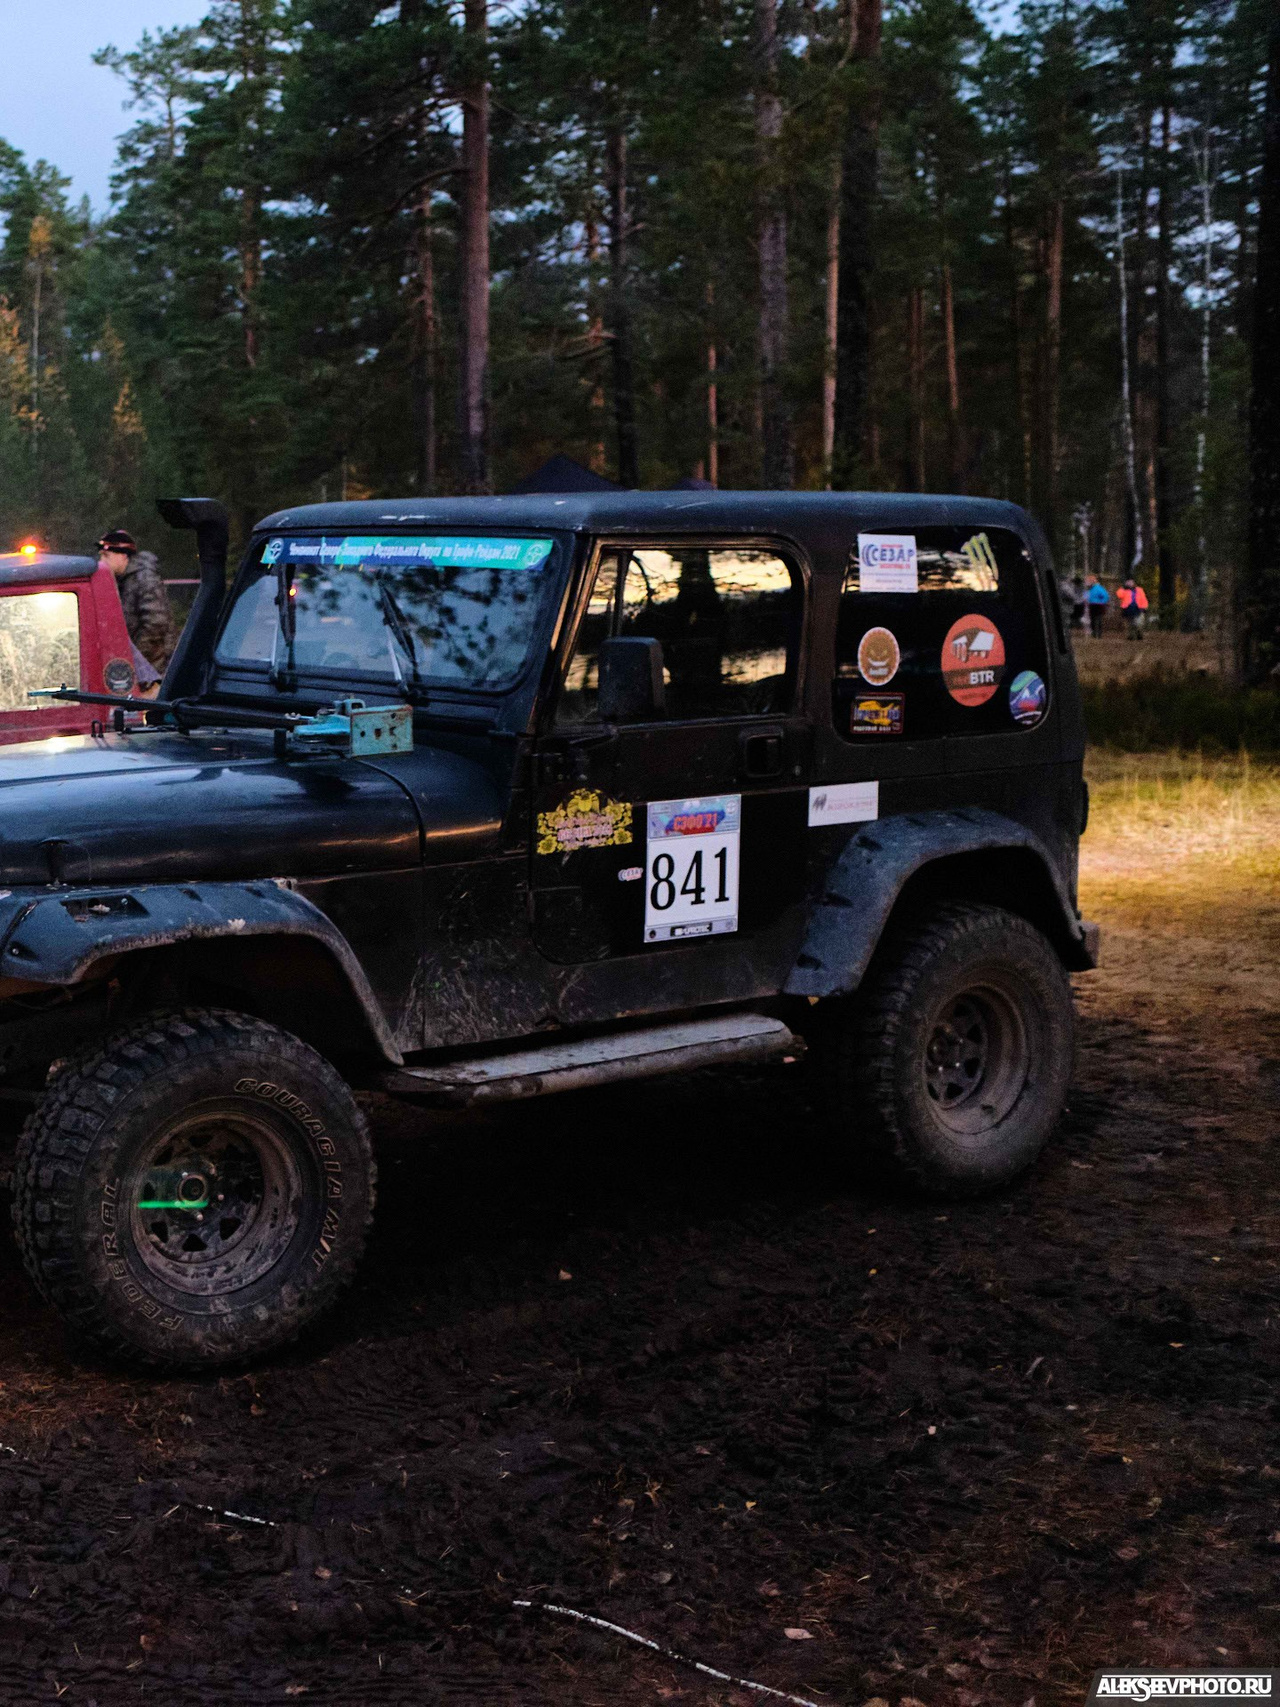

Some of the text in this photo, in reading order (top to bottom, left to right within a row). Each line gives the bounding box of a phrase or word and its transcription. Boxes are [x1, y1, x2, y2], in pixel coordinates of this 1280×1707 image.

[871, 547, 915, 562] СЕЗАР
[969, 669, 995, 685] BTR
[650, 846, 730, 911] 841
[233, 1077, 344, 1199] COURAGIA
[97, 1177, 185, 1331] FEDERAL
